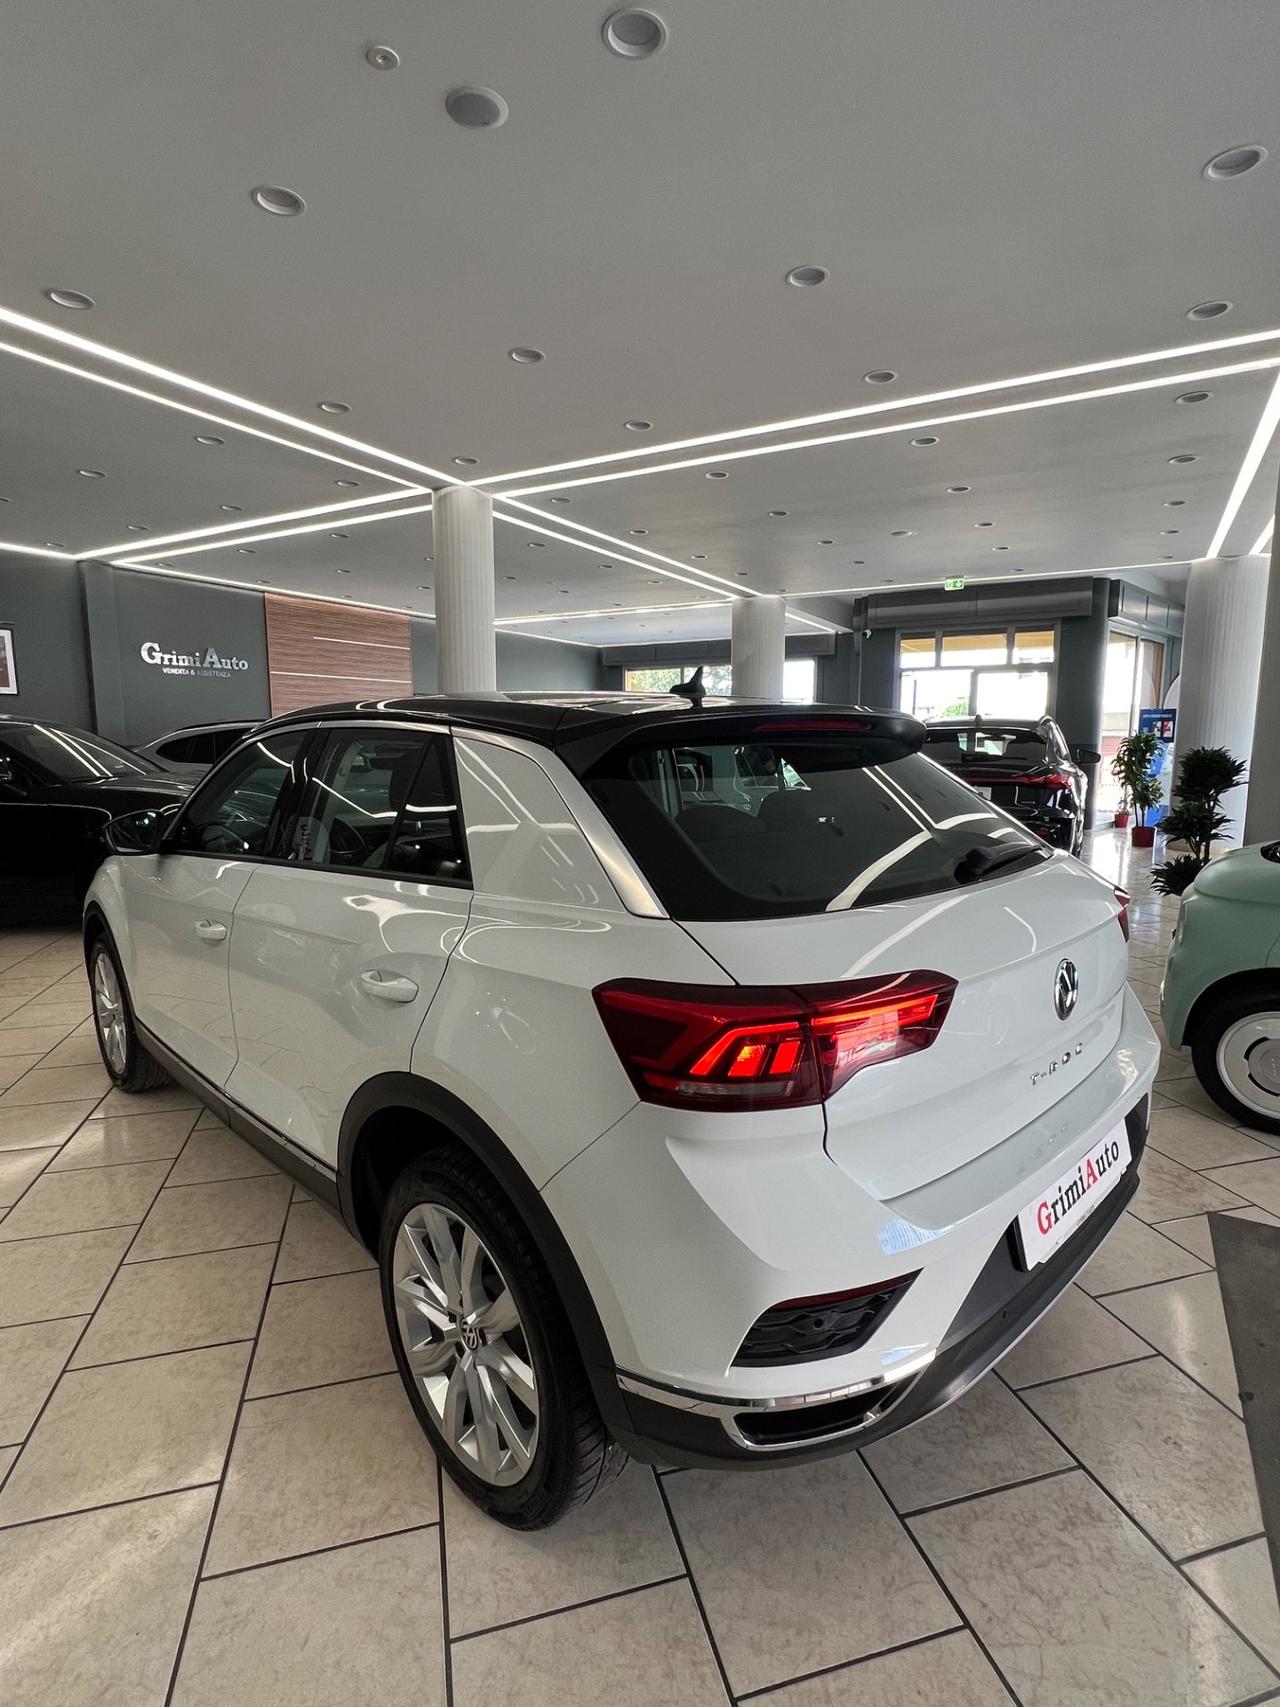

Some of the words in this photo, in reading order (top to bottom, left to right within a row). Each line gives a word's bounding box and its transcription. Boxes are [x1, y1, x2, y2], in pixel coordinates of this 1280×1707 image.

[140, 642, 201, 667] Grimi
[203, 647, 249, 670] Auto
[162, 667, 189, 676] VENDITA
[1037, 1141, 1119, 1235] GrimiAuto
